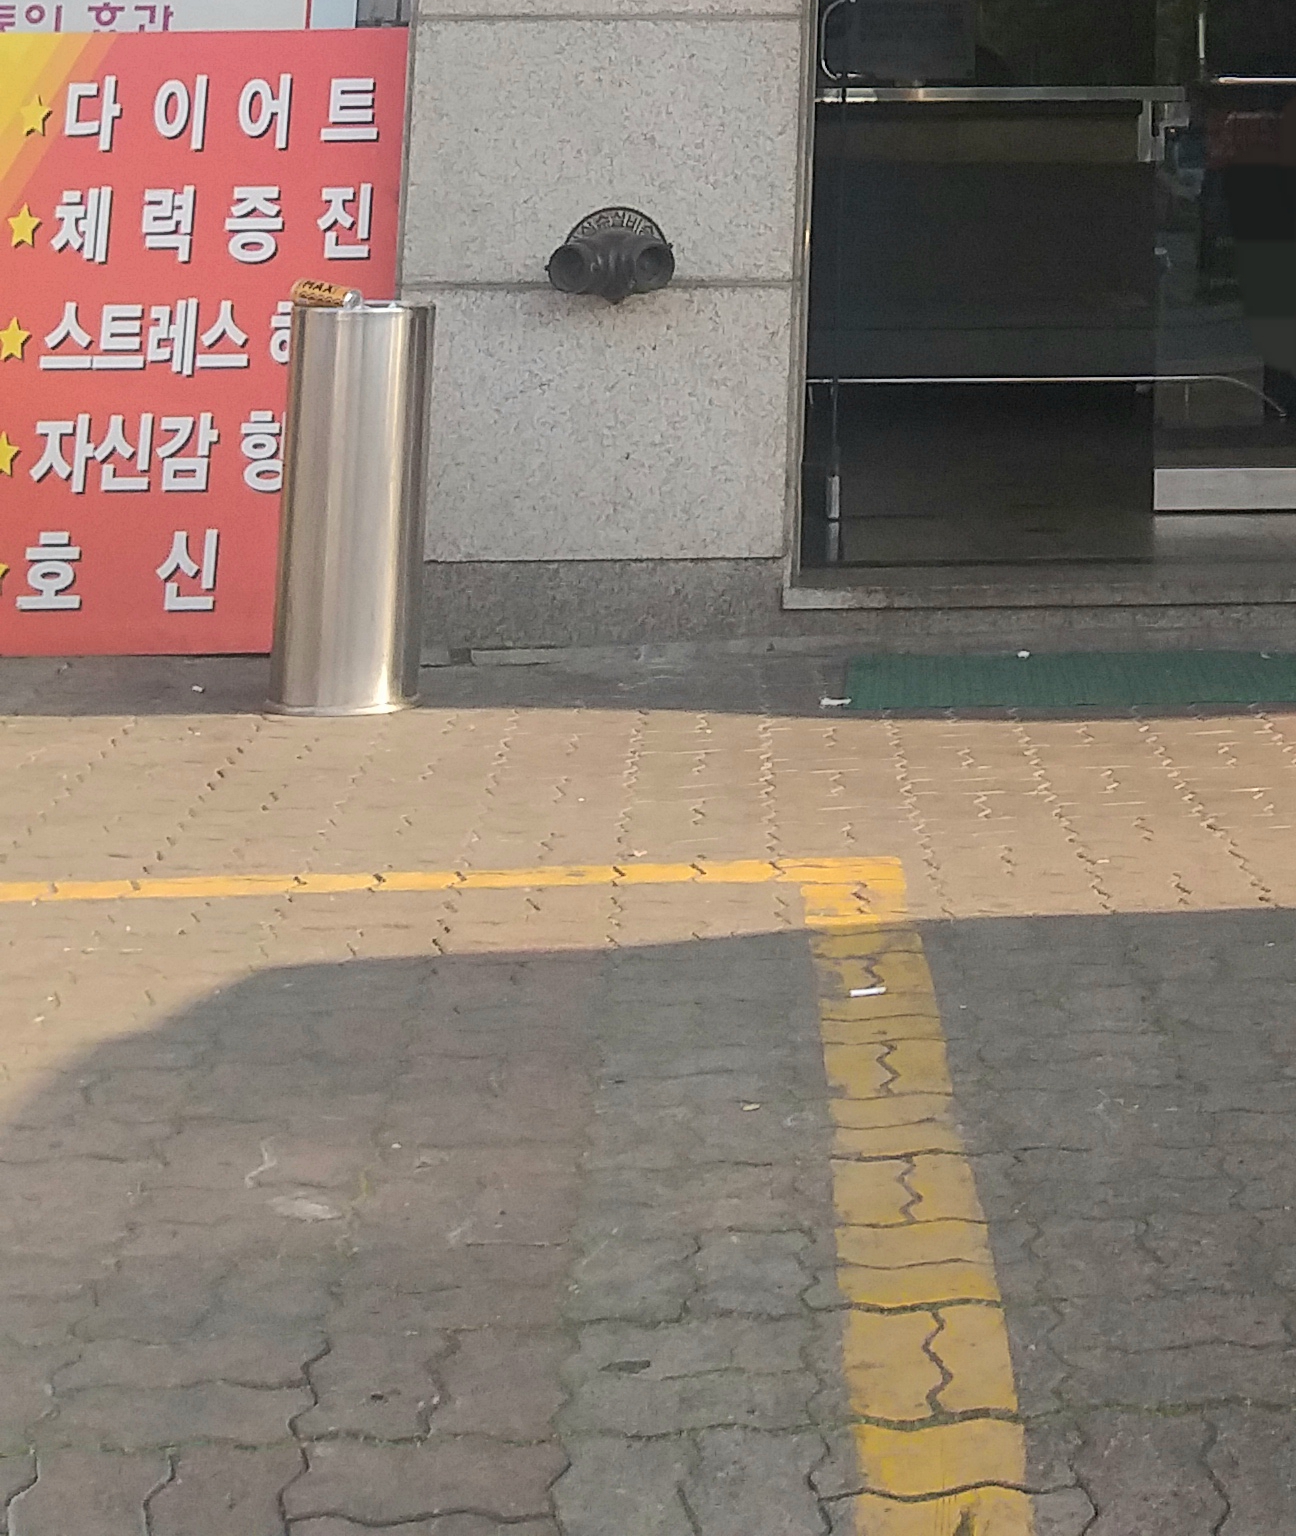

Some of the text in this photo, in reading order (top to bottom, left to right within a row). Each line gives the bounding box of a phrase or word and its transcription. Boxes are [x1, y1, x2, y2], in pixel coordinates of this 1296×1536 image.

[63, 72, 379, 151] 다이어트
[50, 183, 373, 264] 체력증진
[39, 297, 250, 377] 스트레스
[29, 411, 219, 494] 자신감
